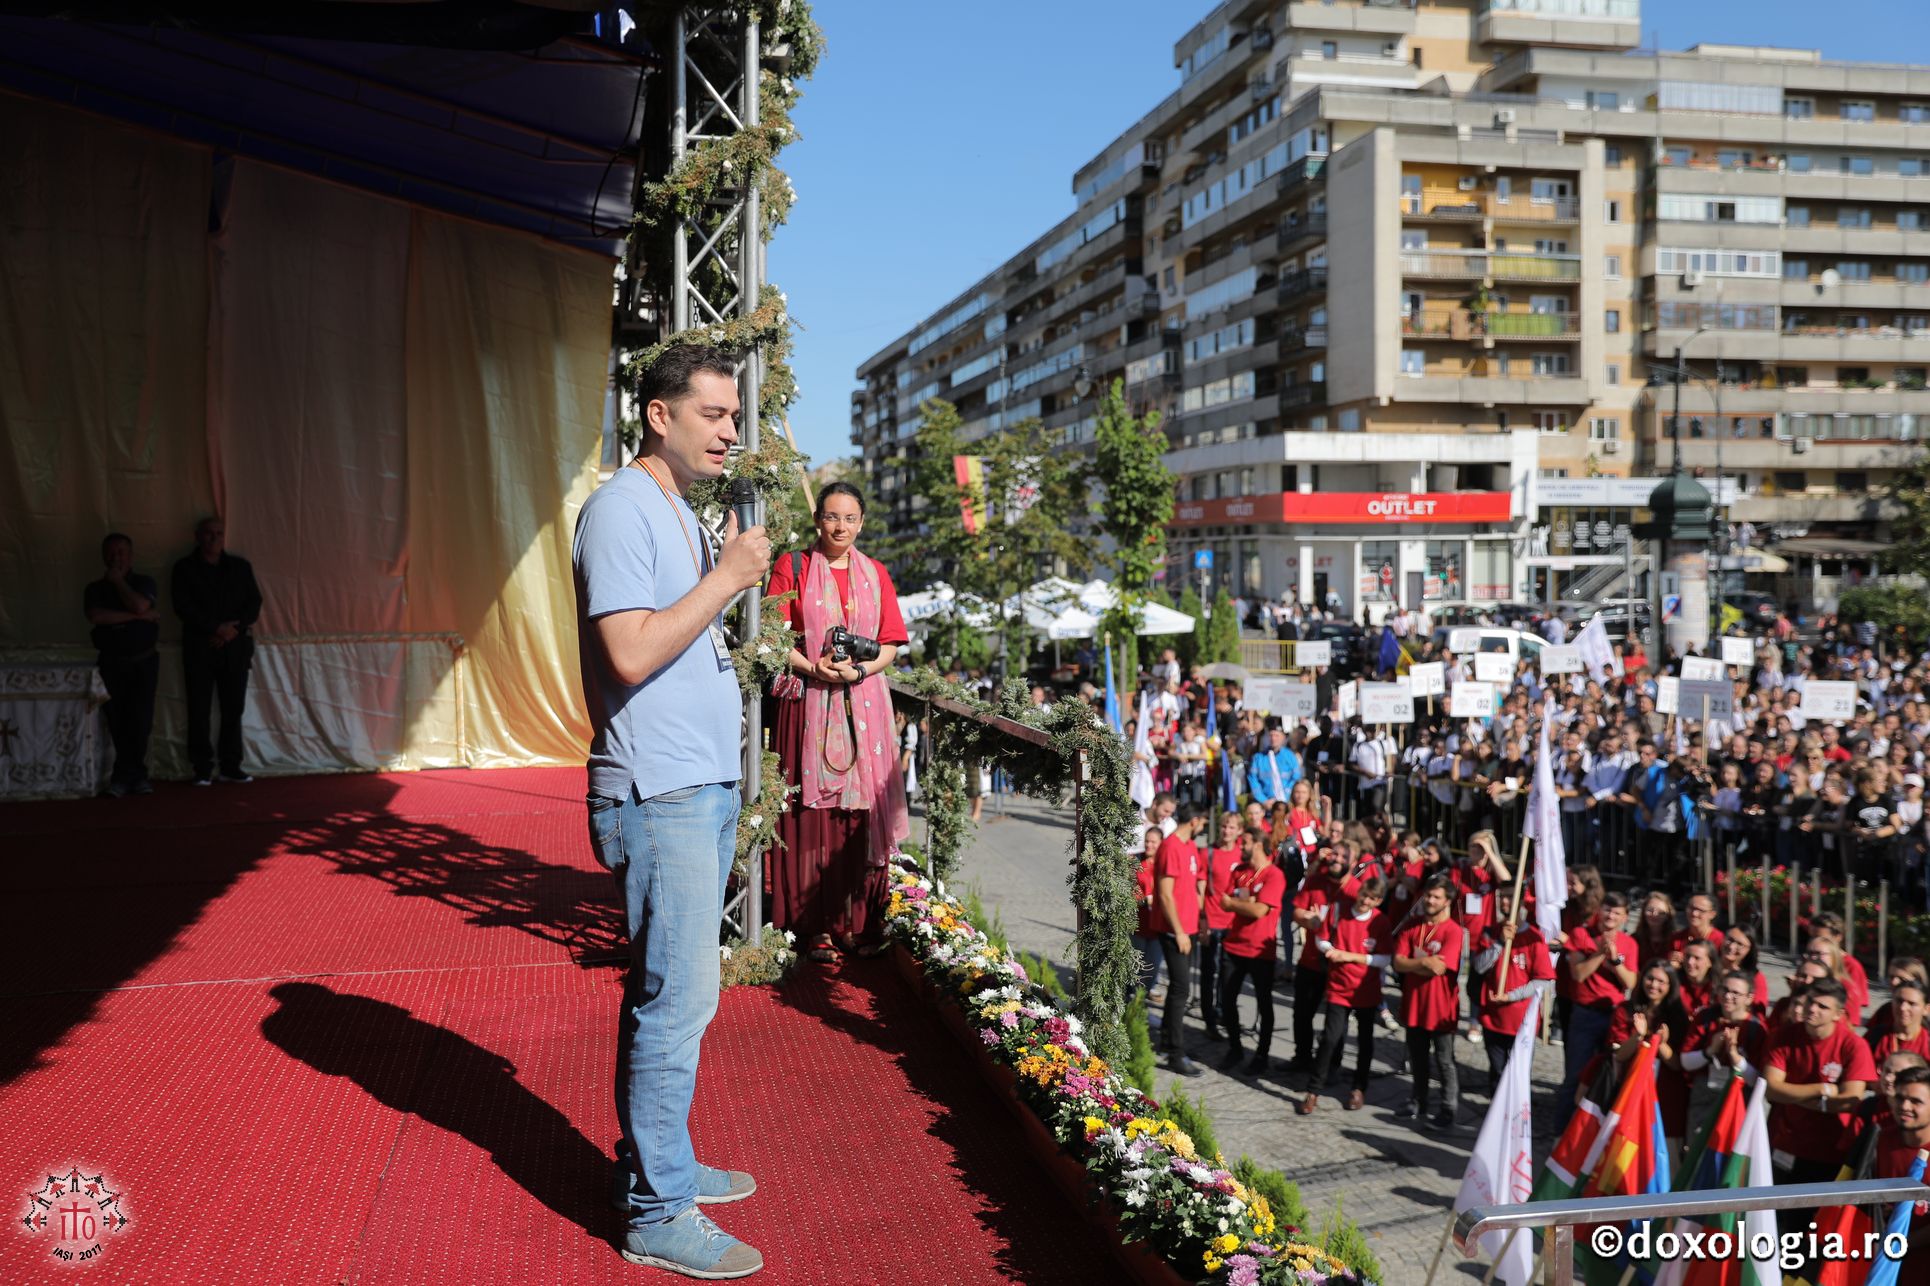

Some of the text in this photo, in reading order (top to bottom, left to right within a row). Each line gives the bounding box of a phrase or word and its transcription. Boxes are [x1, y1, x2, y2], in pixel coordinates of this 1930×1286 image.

[1367, 500, 1437, 515] OUTLET
[1393, 703, 1409, 715] 02
[1476, 698, 1490, 711] 02
